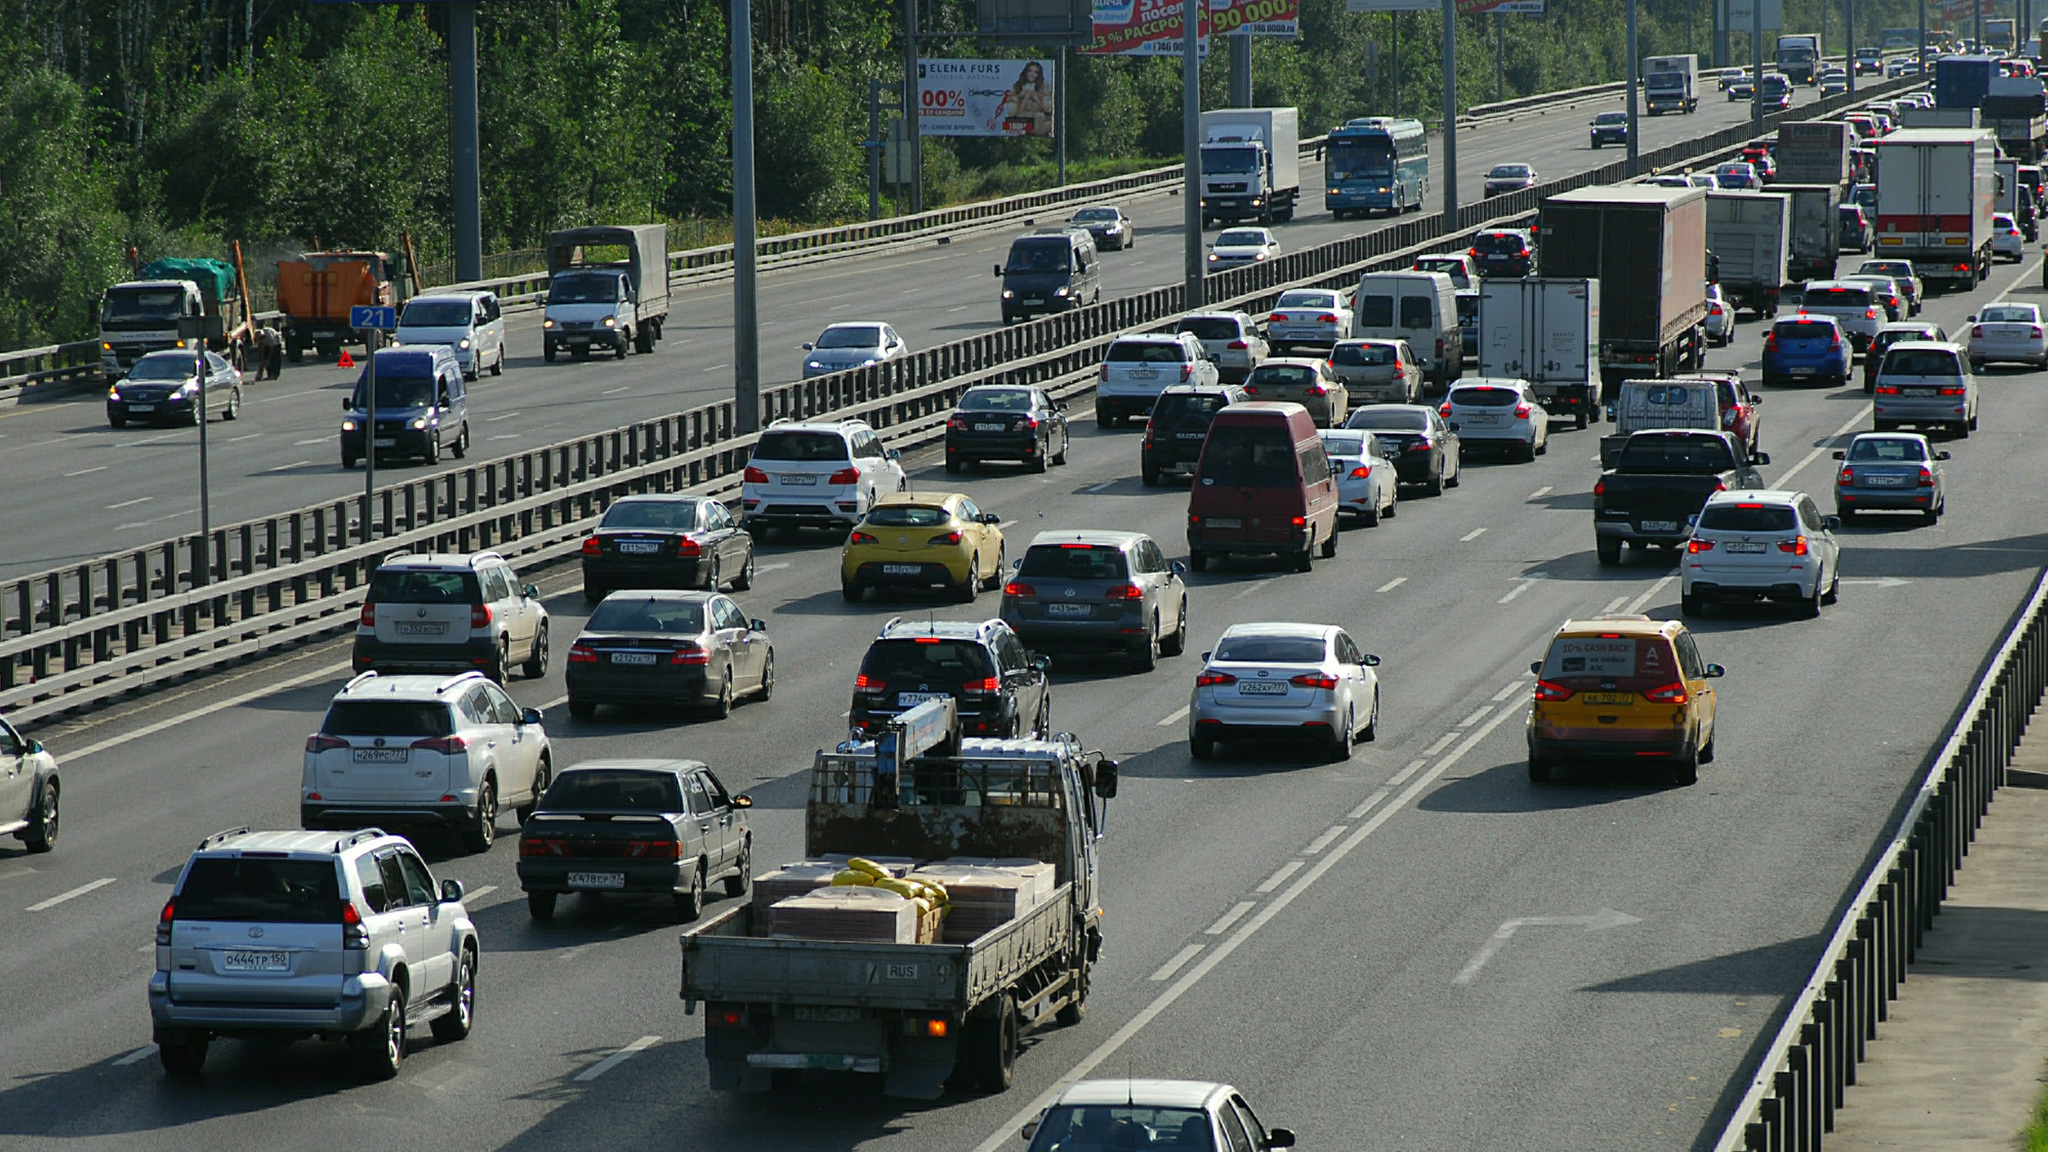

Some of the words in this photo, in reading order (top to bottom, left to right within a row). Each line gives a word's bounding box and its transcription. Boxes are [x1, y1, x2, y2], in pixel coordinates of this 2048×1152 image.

[1141, 0, 1204, 22] поселк
[1212, 8, 1242, 31] 90
[1245, 0, 1287, 22] 000
[1124, 9, 1208, 41] РАССРОЧА
[929, 63, 967, 73] ELENA
[971, 64, 1001, 74] FURS
[921, 89, 965, 107] 00%
[361, 308, 384, 326] 21
[1563, 643, 1582, 653] 10%
[1584, 643, 1607, 652] CASH
[890, 966, 915, 978] RUS
